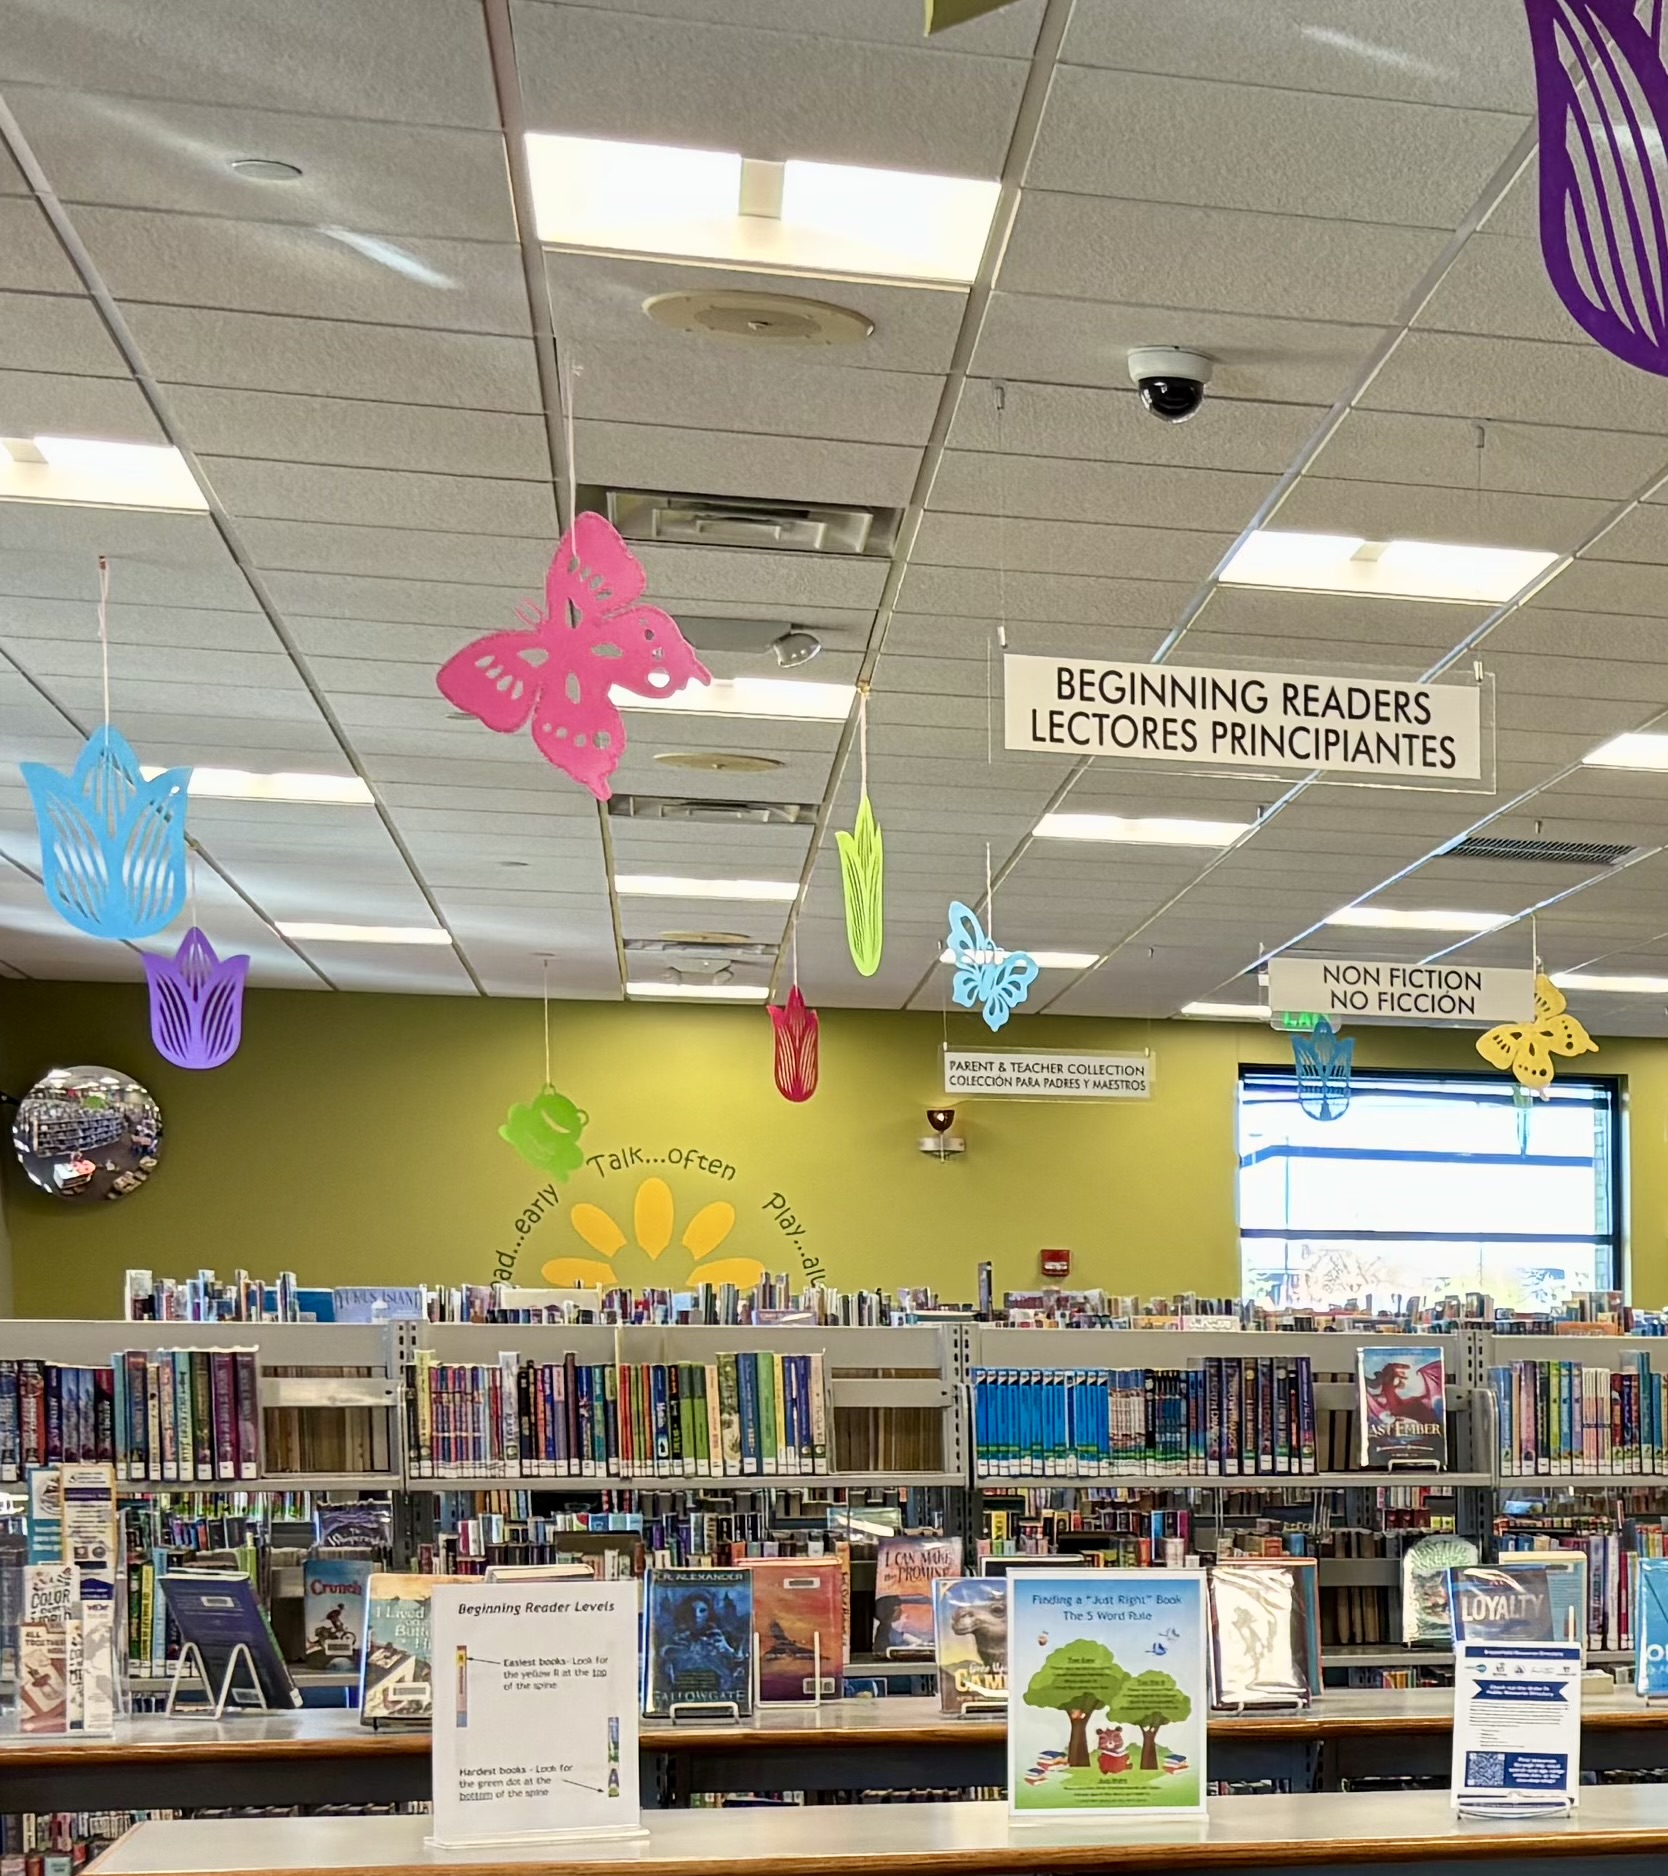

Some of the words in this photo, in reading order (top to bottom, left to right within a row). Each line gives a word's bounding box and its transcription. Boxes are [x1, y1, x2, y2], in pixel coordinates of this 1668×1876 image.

[1056, 666, 1269, 715] BEGINNING
[1283, 682, 1432, 725] READERS
[1031, 708, 1198, 753] LECTORES
[1212, 721, 1457, 770] PRINCIPIANTES
[1323, 965, 1380, 986] NON
[1389, 967, 1482, 991] FICTION
[1330, 989, 1368, 1010] NO
[1378, 989, 1475, 1015] FICCIÓN
[949, 1061, 995, 1072] PARENT
[998, 1061, 1007, 1072] &
[1010, 1062, 1064, 1075] TEACHER
[1068, 1064, 1145, 1077] COLLECTION
[949, 1074, 1013, 1087] COLECCIÓN
[1016, 1077, 1040, 1088] PARA
[1044, 1077, 1080, 1089] PADRES
[1084, 1079, 1091, 1089] Y
[1093, 1080, 1146, 1091] MAESTROS
[1395, 1421, 1441, 1436] EMBER
[895, 1551, 915, 1566] CAN
[921, 1549, 952, 1565] MAKE
[676, 1573, 743, 1581] ALEXANDER
[311, 1580, 362, 1596] Crunch
[31, 1589, 71, 1609] COLOR
[1032, 1594, 1073, 1606] Finding
[1156, 1594, 1182, 1605] Book
[386, 1605, 425, 1618] Lived
[457, 1602, 521, 1618] Beginning
[525, 1602, 570, 1613] Reader
[574, 1601, 615, 1612] Levels
[1063, 1611, 1084, 1621] The
[1097, 1611, 1124, 1621] Word
[1128, 1611, 1152, 1621] Rule
[1461, 1595, 1545, 1622] LOYALTY
[503, 1658, 536, 1667] Easiest
[572, 1656, 592, 1666] Look
[595, 1655, 608, 1664] for
[503, 1669, 519, 1679] the
[520, 1669, 551, 1680] yellow
[562, 1669, 572, 1677] at
[574, 1668, 589, 1677] the
[592, 1668, 607, 1678] top
[503, 1681, 513, 1691] of
[516, 1681, 532, 1690] the
[533, 1681, 557, 1692] spine
[459, 1767, 497, 1777] Hardest
[499, 1766, 526, 1776] books
[559, 1764, 573, 1773] for
[459, 1779, 475, 1789] the
[477, 1780, 504, 1791] green
[524, 1778, 534, 1786] at
[536, 1776, 552, 1785] the
[459, 1790, 493, 1801] bottom
[496, 1790, 506, 1799] of
[508, 1790, 524, 1799] the
[525, 1789, 549, 1799] spine
